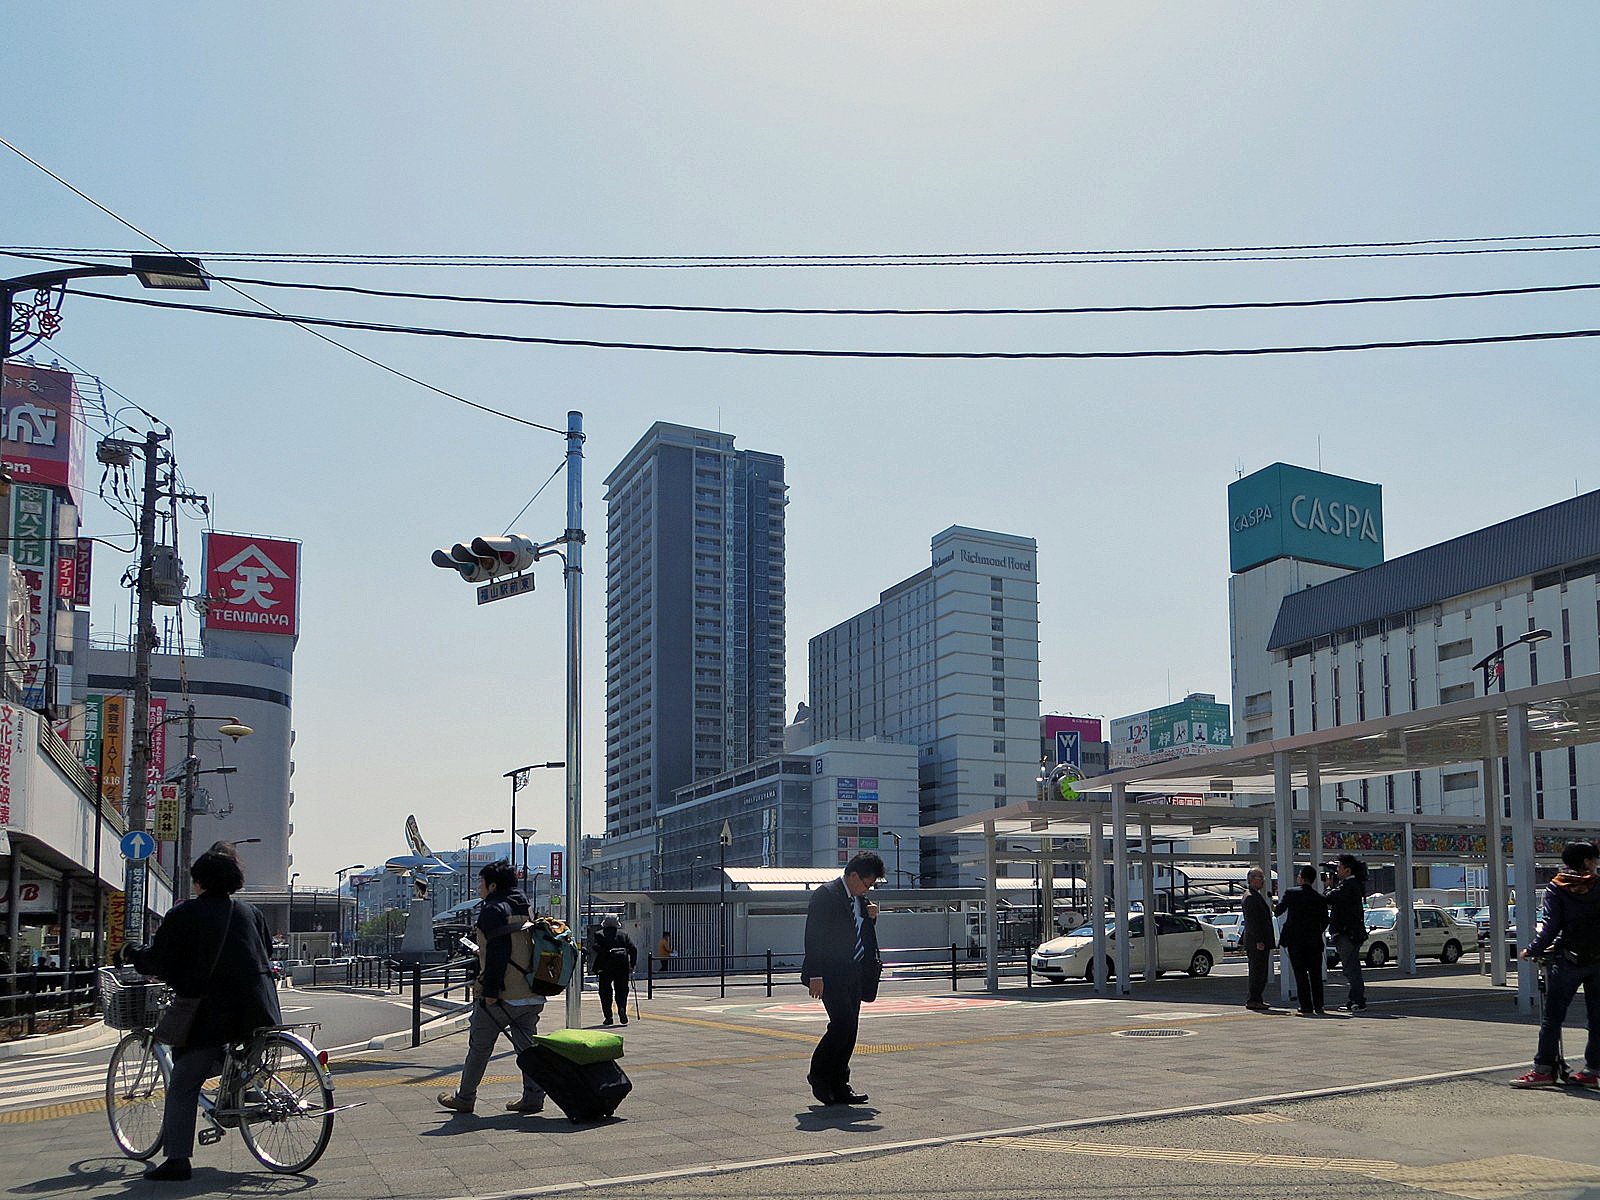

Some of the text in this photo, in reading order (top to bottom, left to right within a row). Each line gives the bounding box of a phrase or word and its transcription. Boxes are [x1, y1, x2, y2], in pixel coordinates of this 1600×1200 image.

[1233, 504, 1273, 532] CASPA
[1291, 495, 1379, 543] CASPA
[961, 549, 1032, 572] Richmond Hotel
[60, 558, 72, 597] アイフル
[213, 608, 289, 626] TENMAYA
[160, 785, 177, 799] 質
